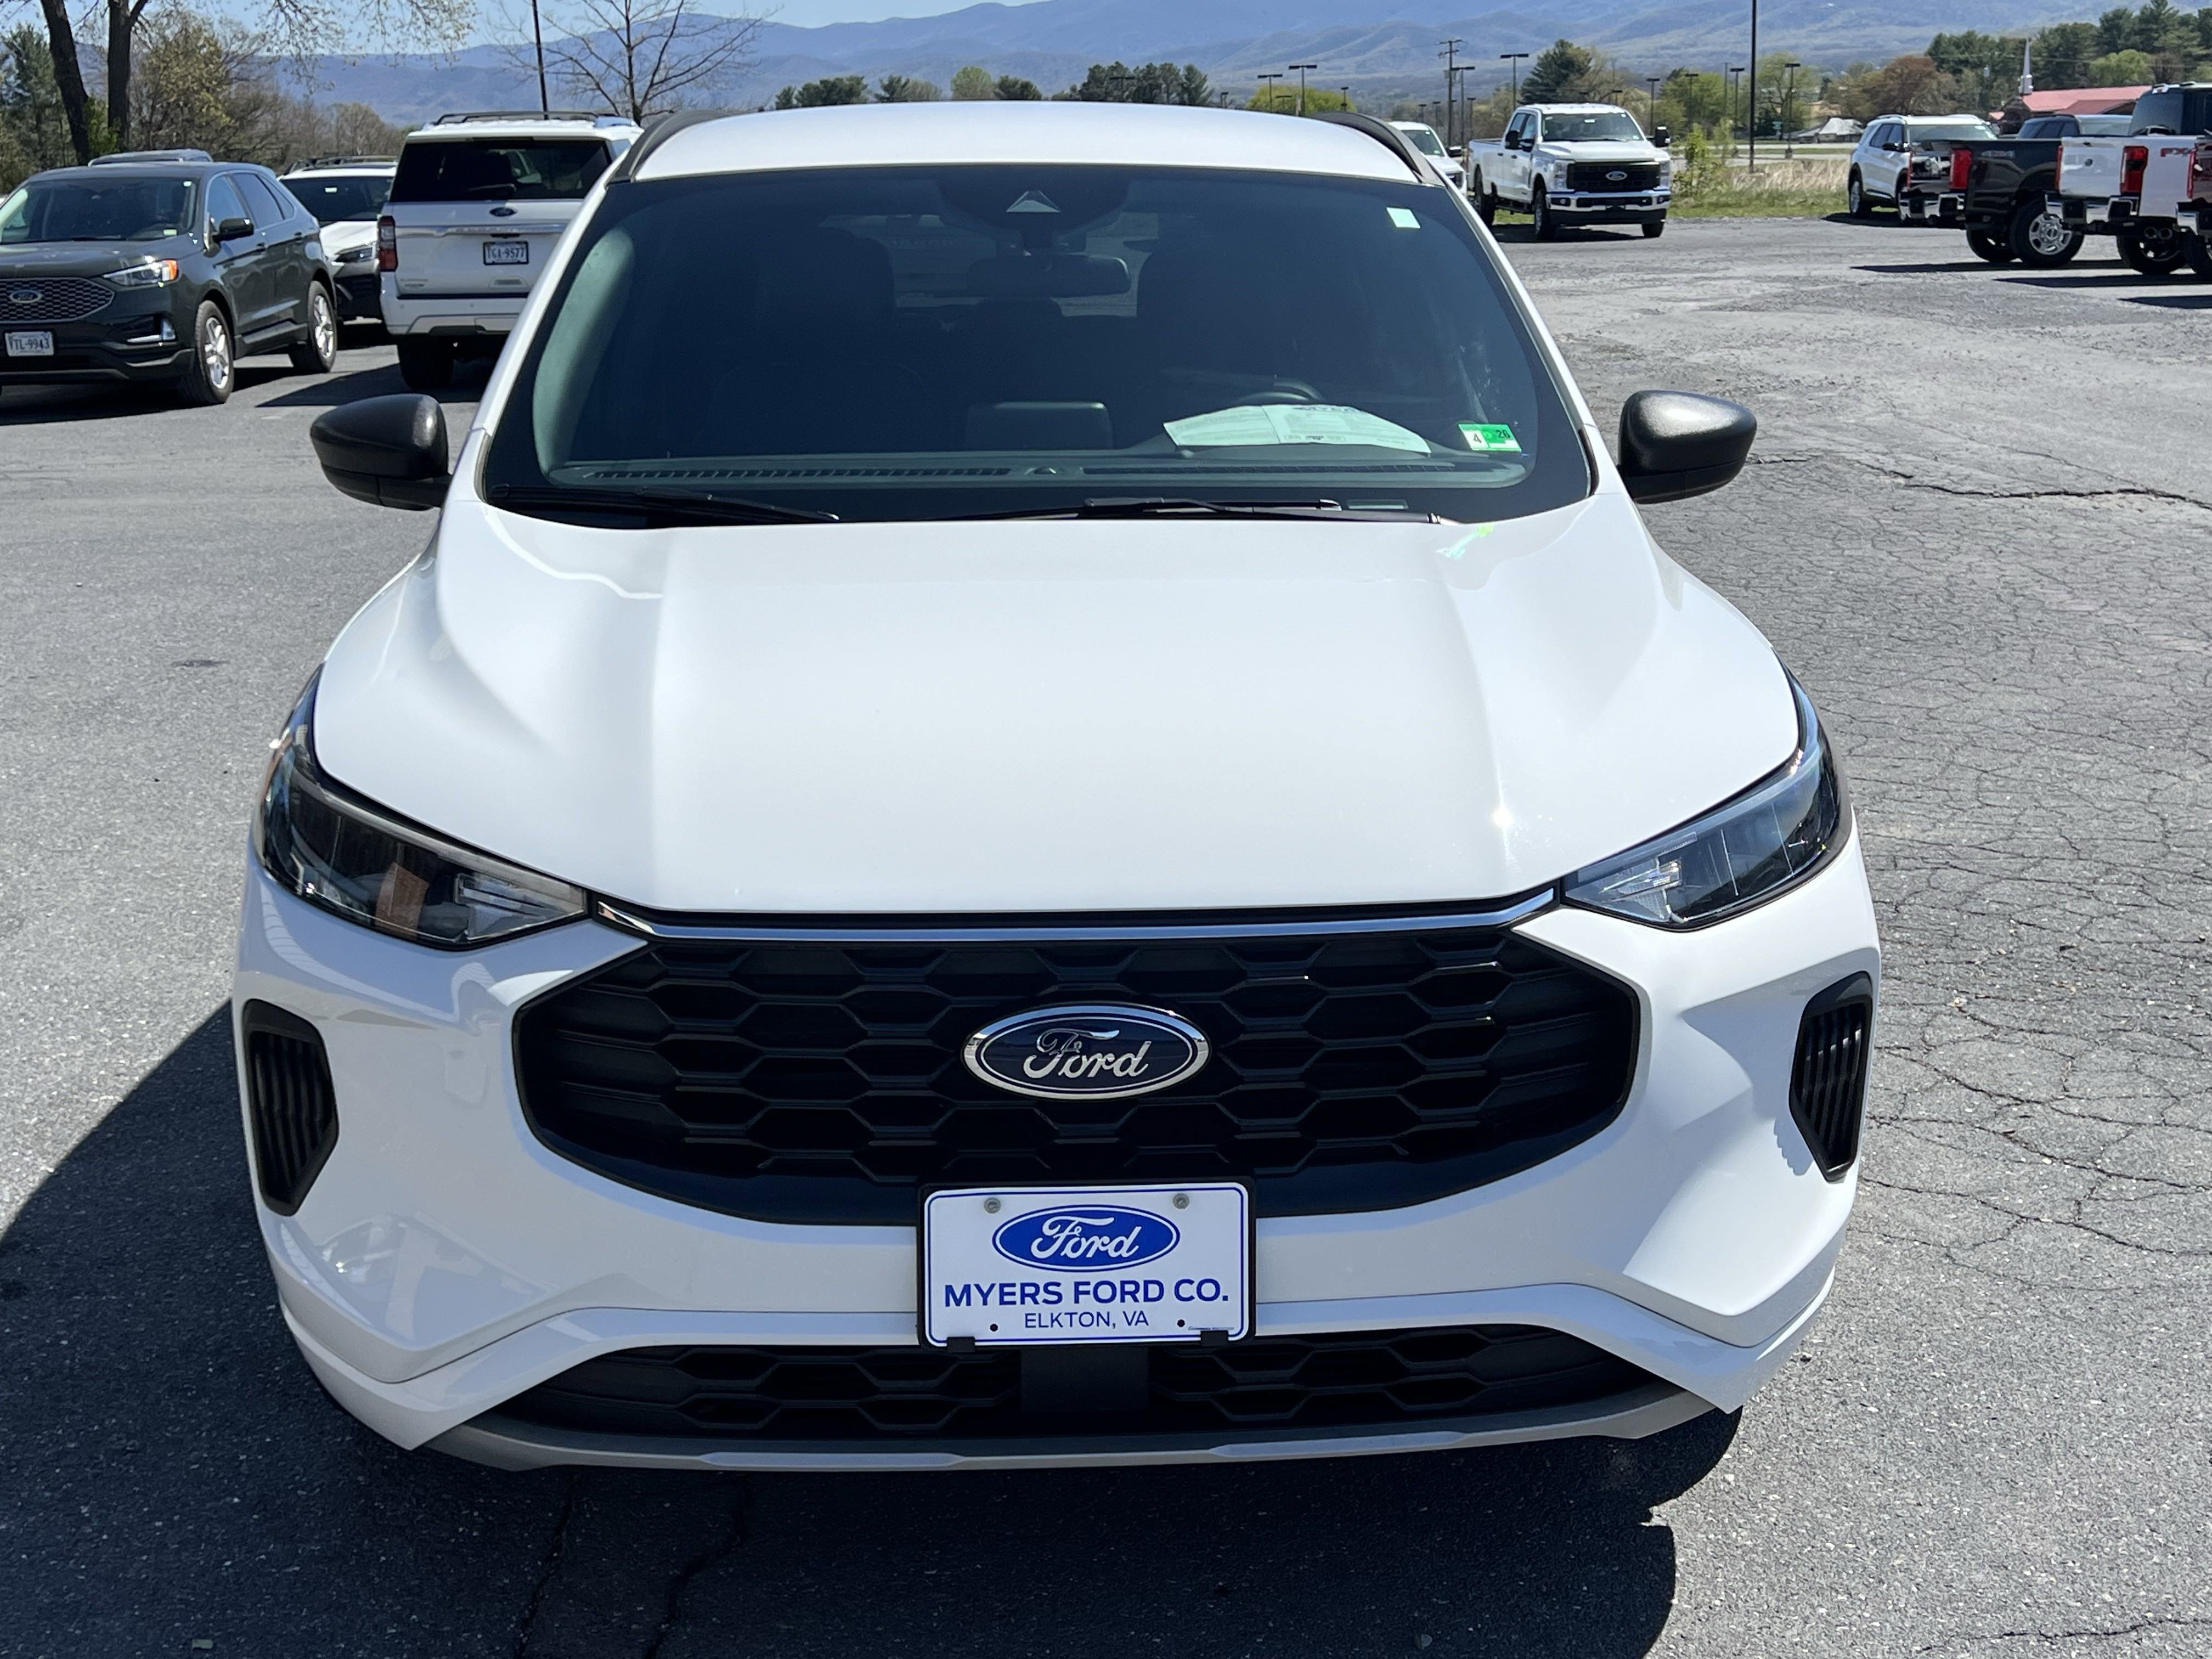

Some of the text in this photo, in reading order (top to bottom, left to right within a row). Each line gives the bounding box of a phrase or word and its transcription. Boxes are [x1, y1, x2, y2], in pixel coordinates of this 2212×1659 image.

[1473, 433, 1482, 444] 4
[1023, 1028, 1152, 1079] Ford
[1030, 1213, 1142, 1260] Ford
[944, 1278, 1229, 1307] MYERS FORD CO.
[1024, 1311, 1149, 1330] ELKTON, VA
